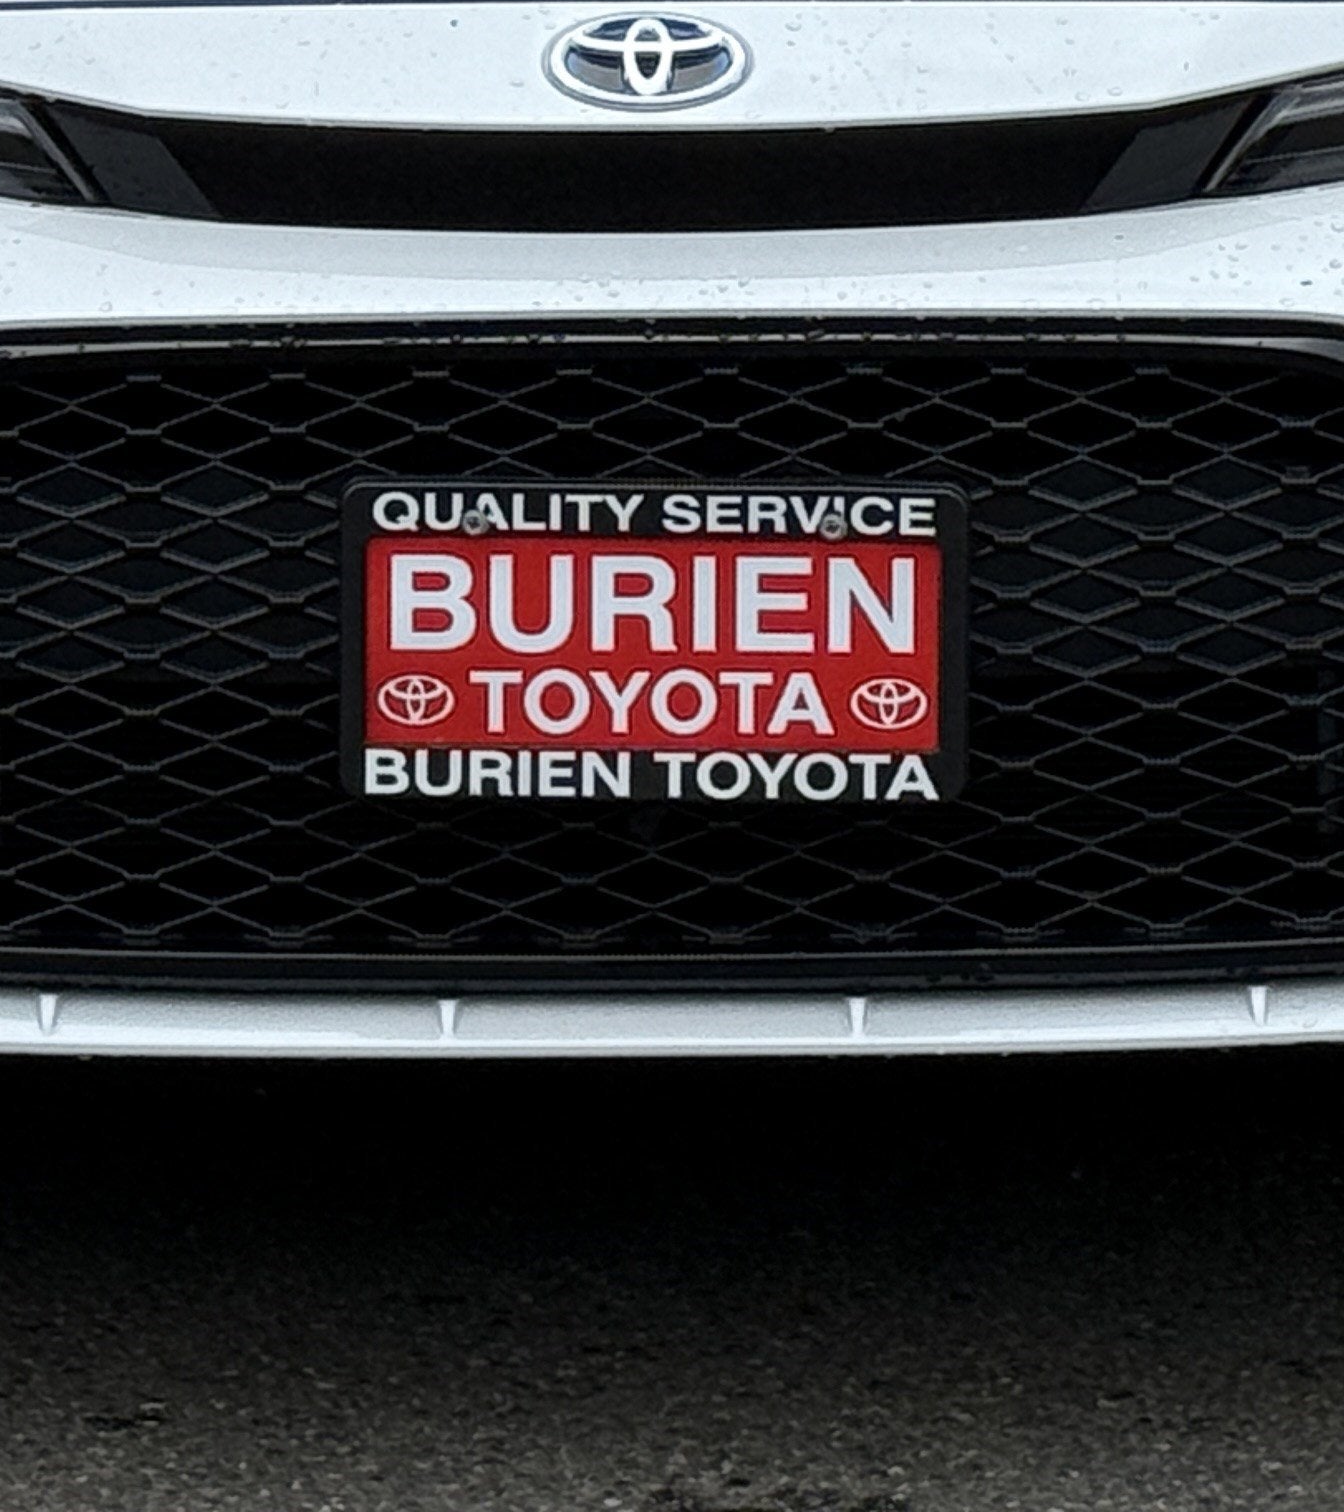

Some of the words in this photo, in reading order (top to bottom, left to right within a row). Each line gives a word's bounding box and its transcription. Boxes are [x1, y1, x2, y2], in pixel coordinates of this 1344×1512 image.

[372, 491, 645, 531] QUALITY
[389, 553, 916, 654] BURIEN
[469, 668, 834, 736] TOYOTA
[364, 748, 630, 798] BURIEN
[654, 751, 939, 801] TOYOTA
